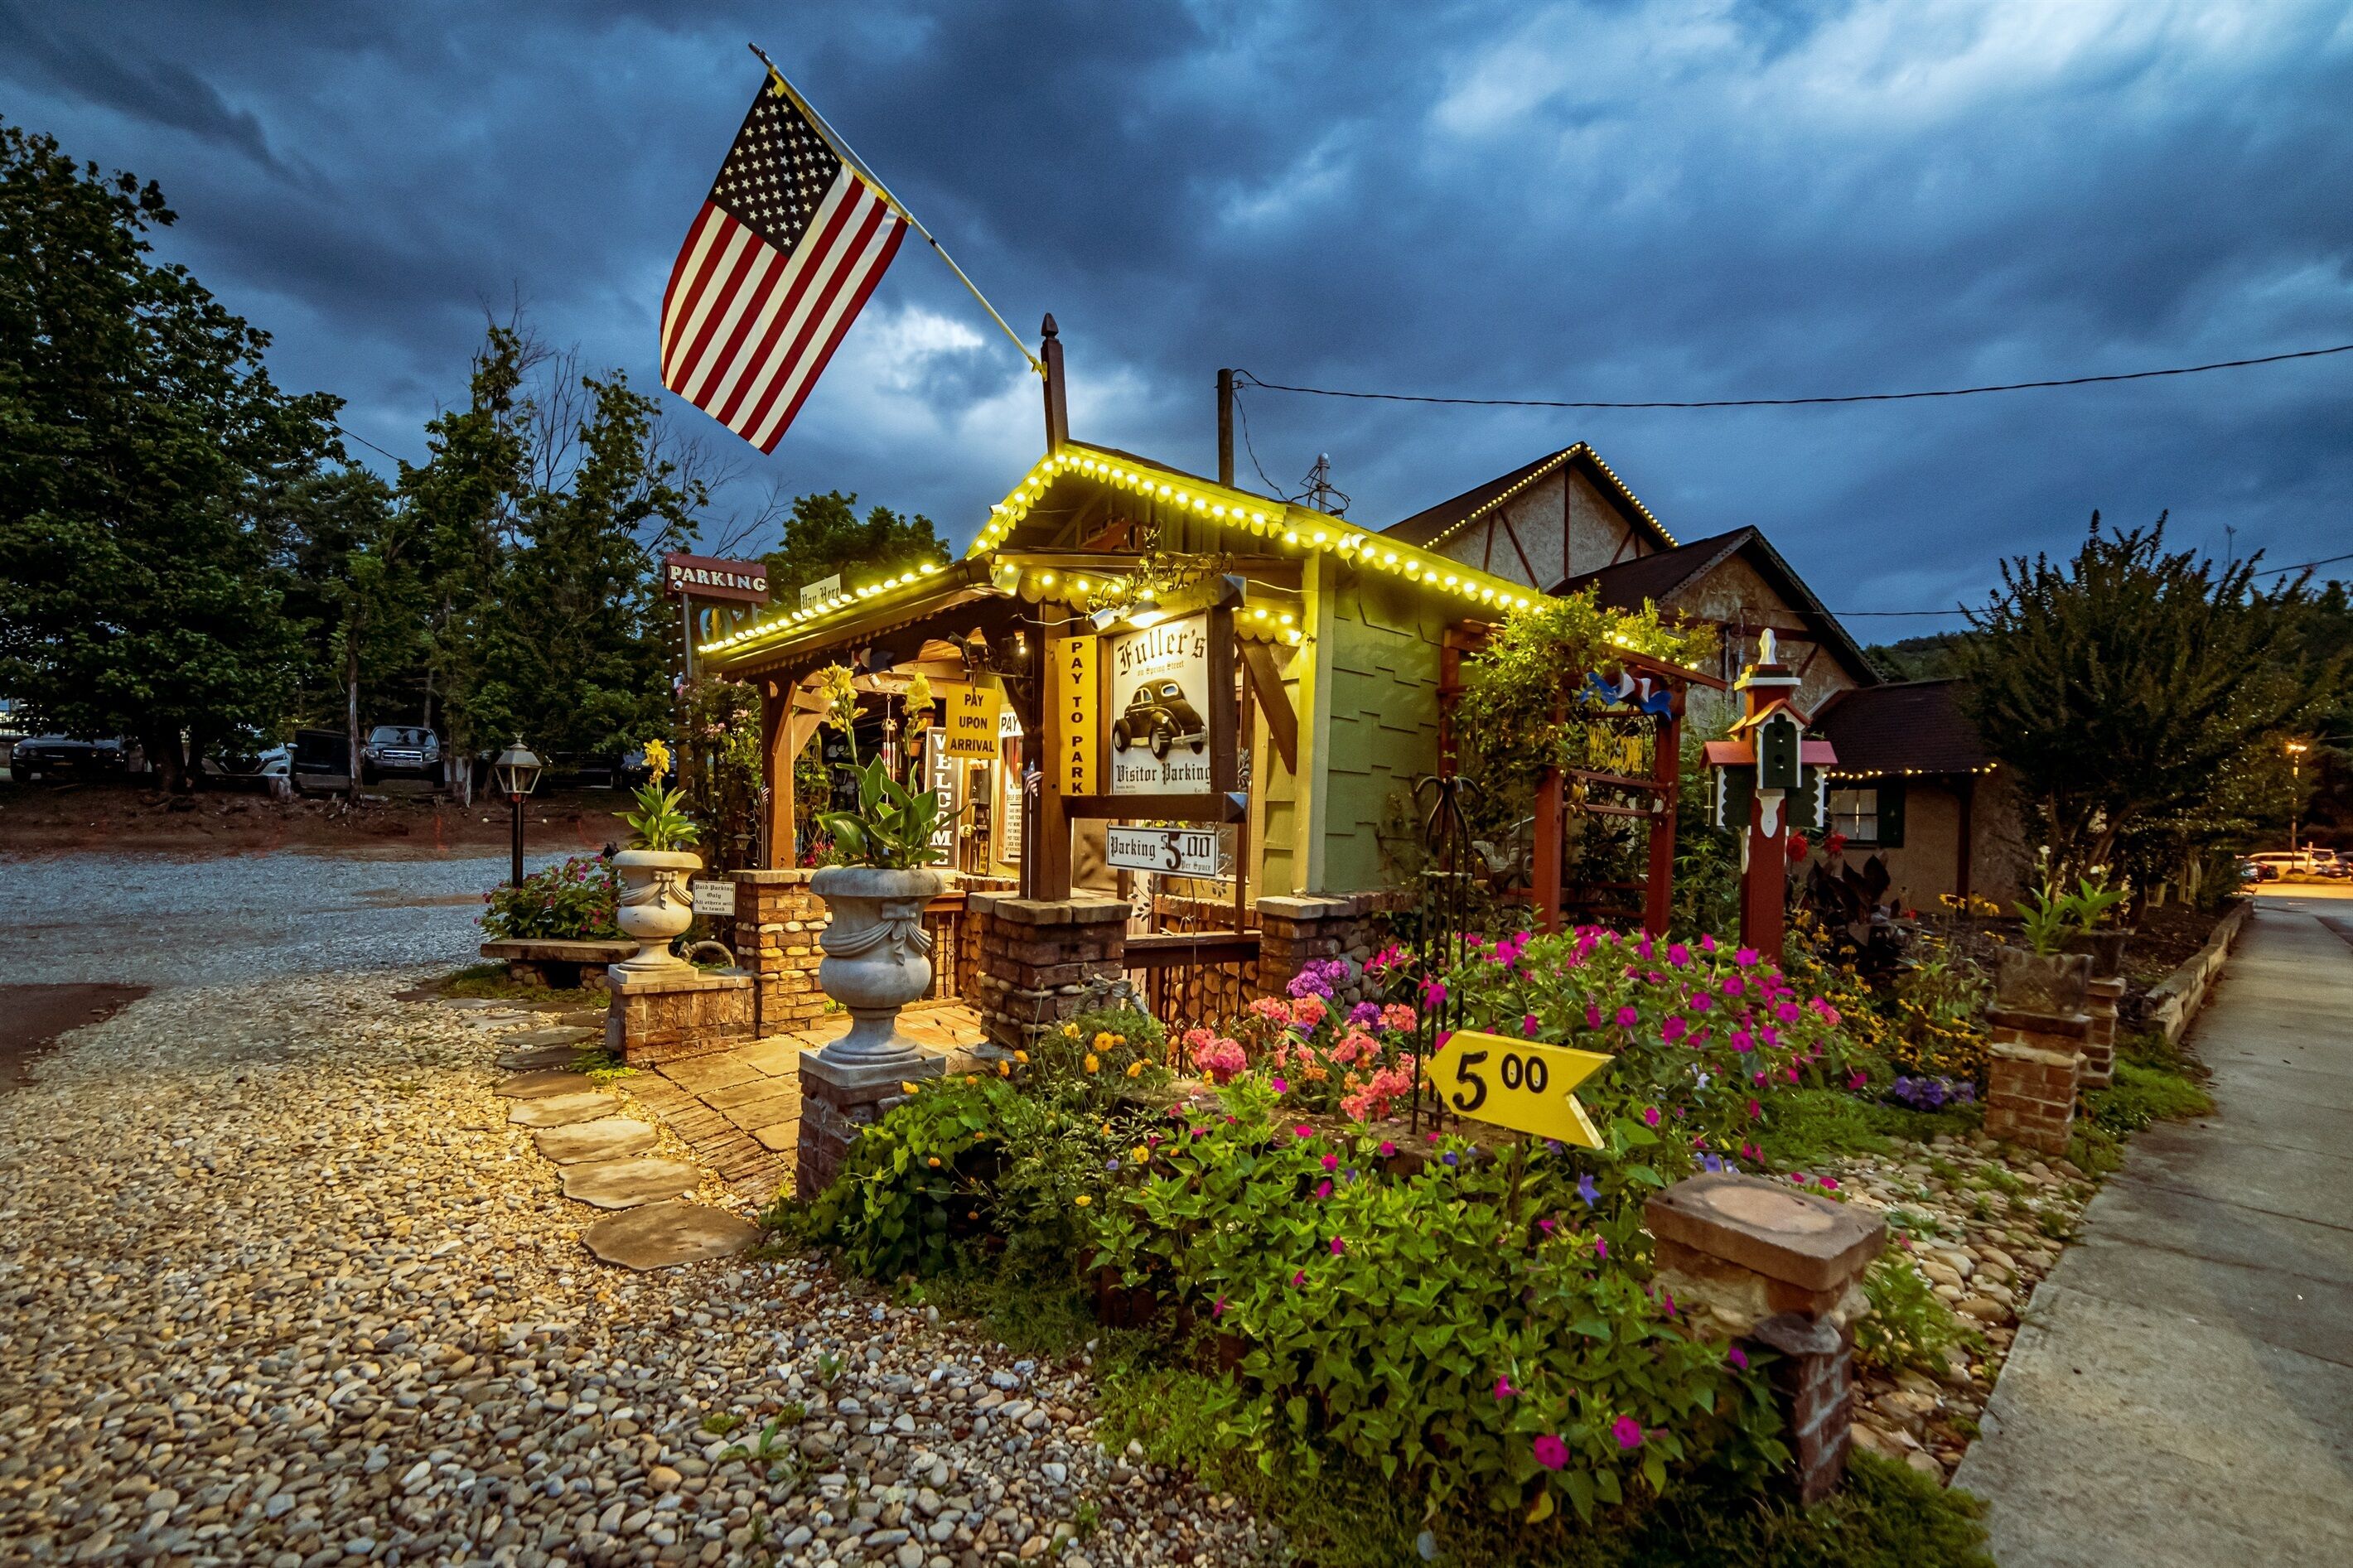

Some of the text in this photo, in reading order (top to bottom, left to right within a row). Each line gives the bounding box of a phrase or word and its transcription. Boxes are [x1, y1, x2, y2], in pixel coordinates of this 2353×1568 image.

[669, 565, 766, 591] PARKING
[1117, 628, 1206, 677] Fuller's
[964, 693, 983, 707] PAY
[959, 716, 988, 729] UPON
[1001, 716, 1018, 733] PAY
[1070, 641, 1084, 794] PAY TO PARK
[949, 737, 995, 752] ARRIVAL
[1116, 762, 1210, 785] Visitor Parking
[1110, 836, 1156, 861] Parking
[1181, 861, 1191, 870] Per
